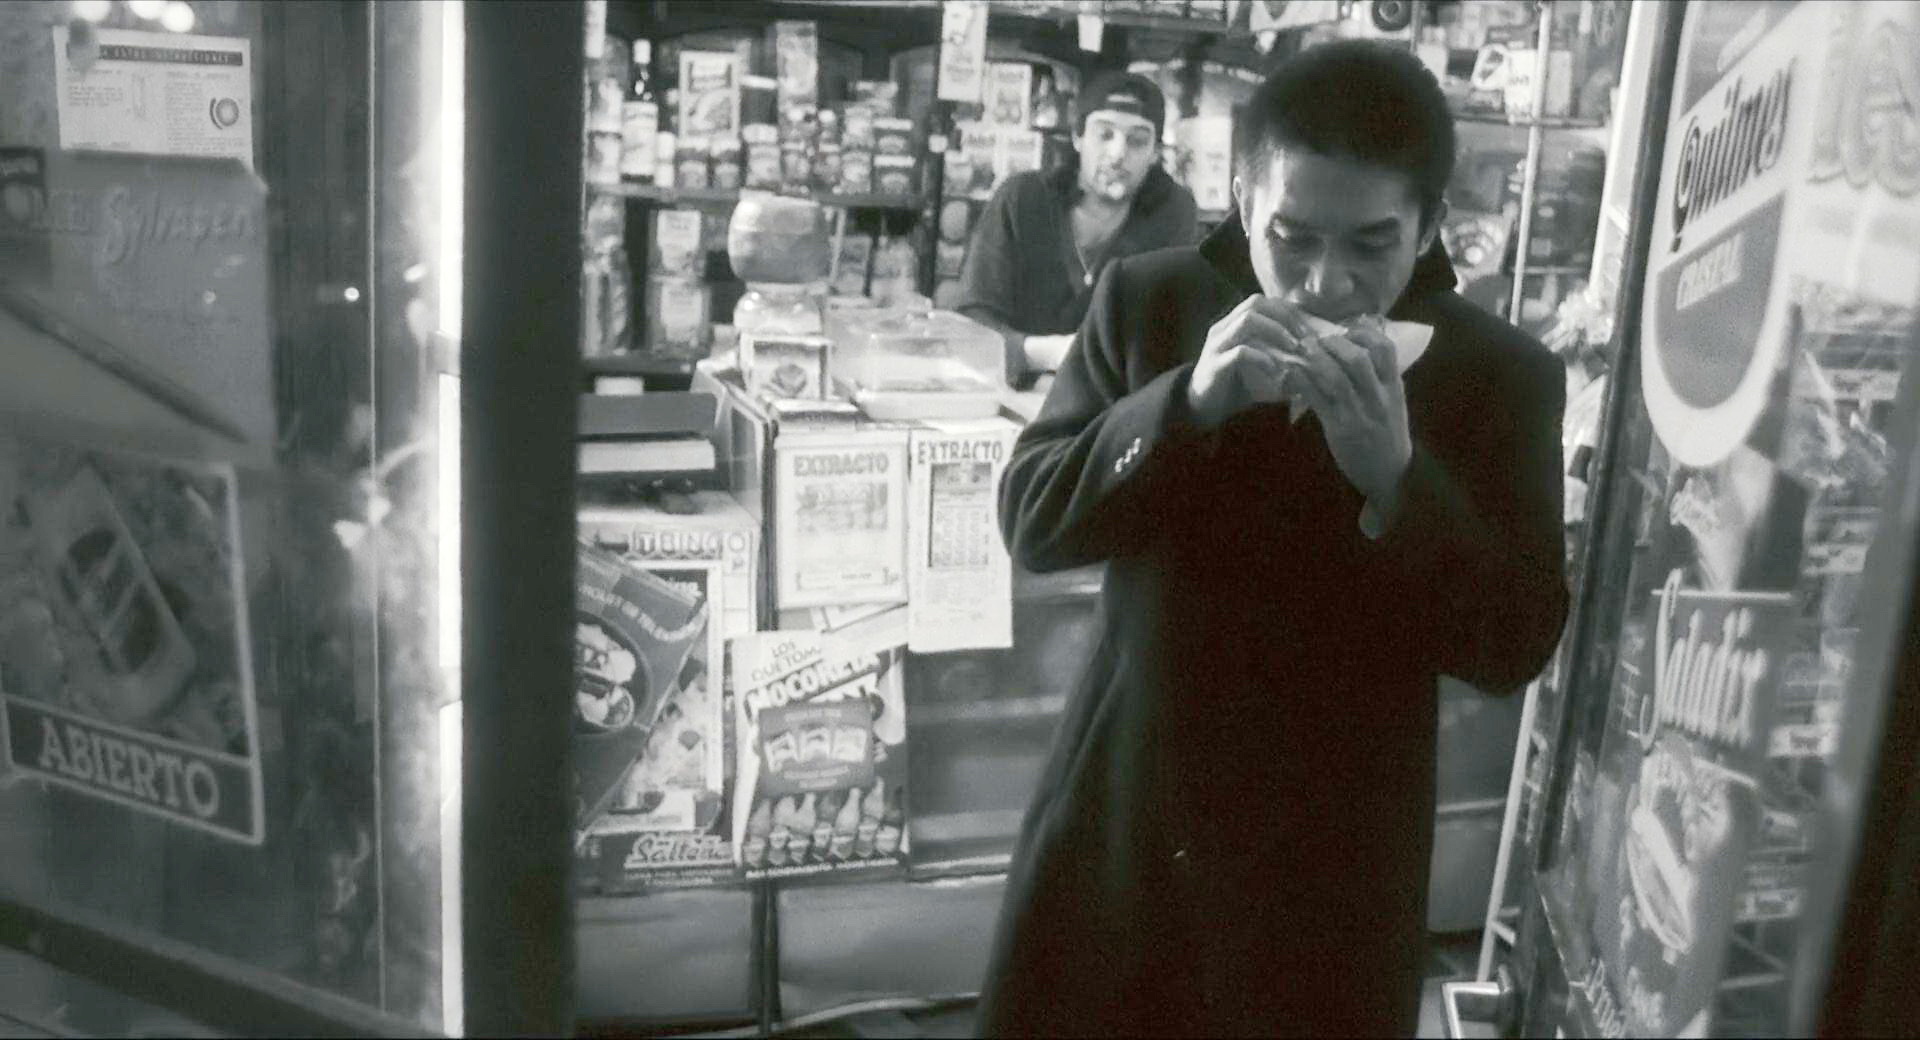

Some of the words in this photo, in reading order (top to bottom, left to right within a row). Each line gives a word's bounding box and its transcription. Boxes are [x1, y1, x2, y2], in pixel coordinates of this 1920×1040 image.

[793, 451, 890, 477] EXTRACTO
[917, 439, 1003, 465] EXTRACTO
[1639, 566, 1768, 752] Saladix
[40, 716, 219, 818] ABIERTO
